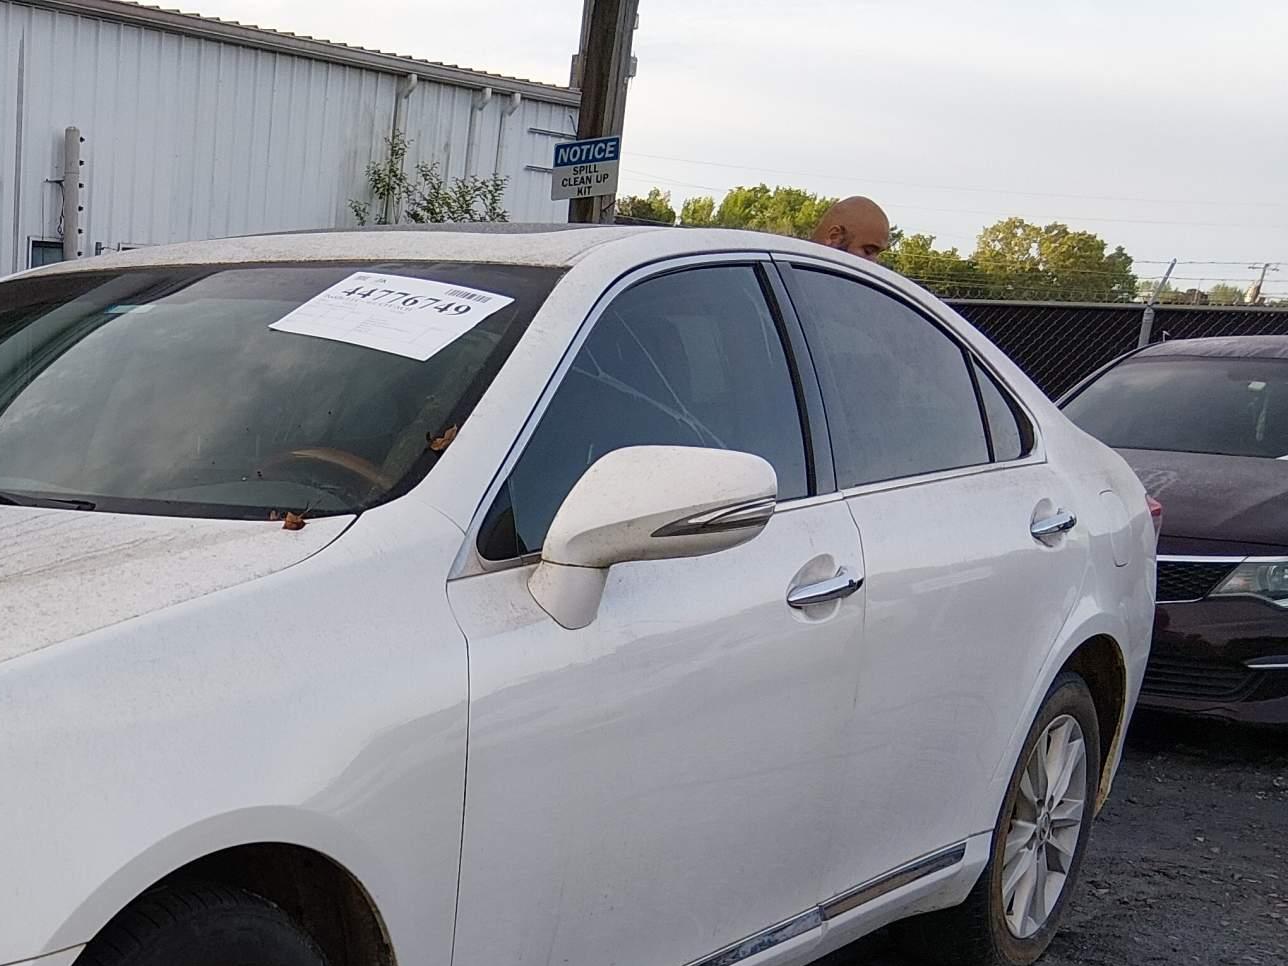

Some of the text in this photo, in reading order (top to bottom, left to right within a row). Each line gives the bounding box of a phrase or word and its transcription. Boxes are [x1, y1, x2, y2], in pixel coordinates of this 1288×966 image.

[557, 141, 617, 163] NOTICE
[573, 164, 599, 175] SPILL
[561, 173, 609, 187] CLEAN UP
[577, 186, 592, 196] KIT
[342, 286, 472, 316] 44776749
